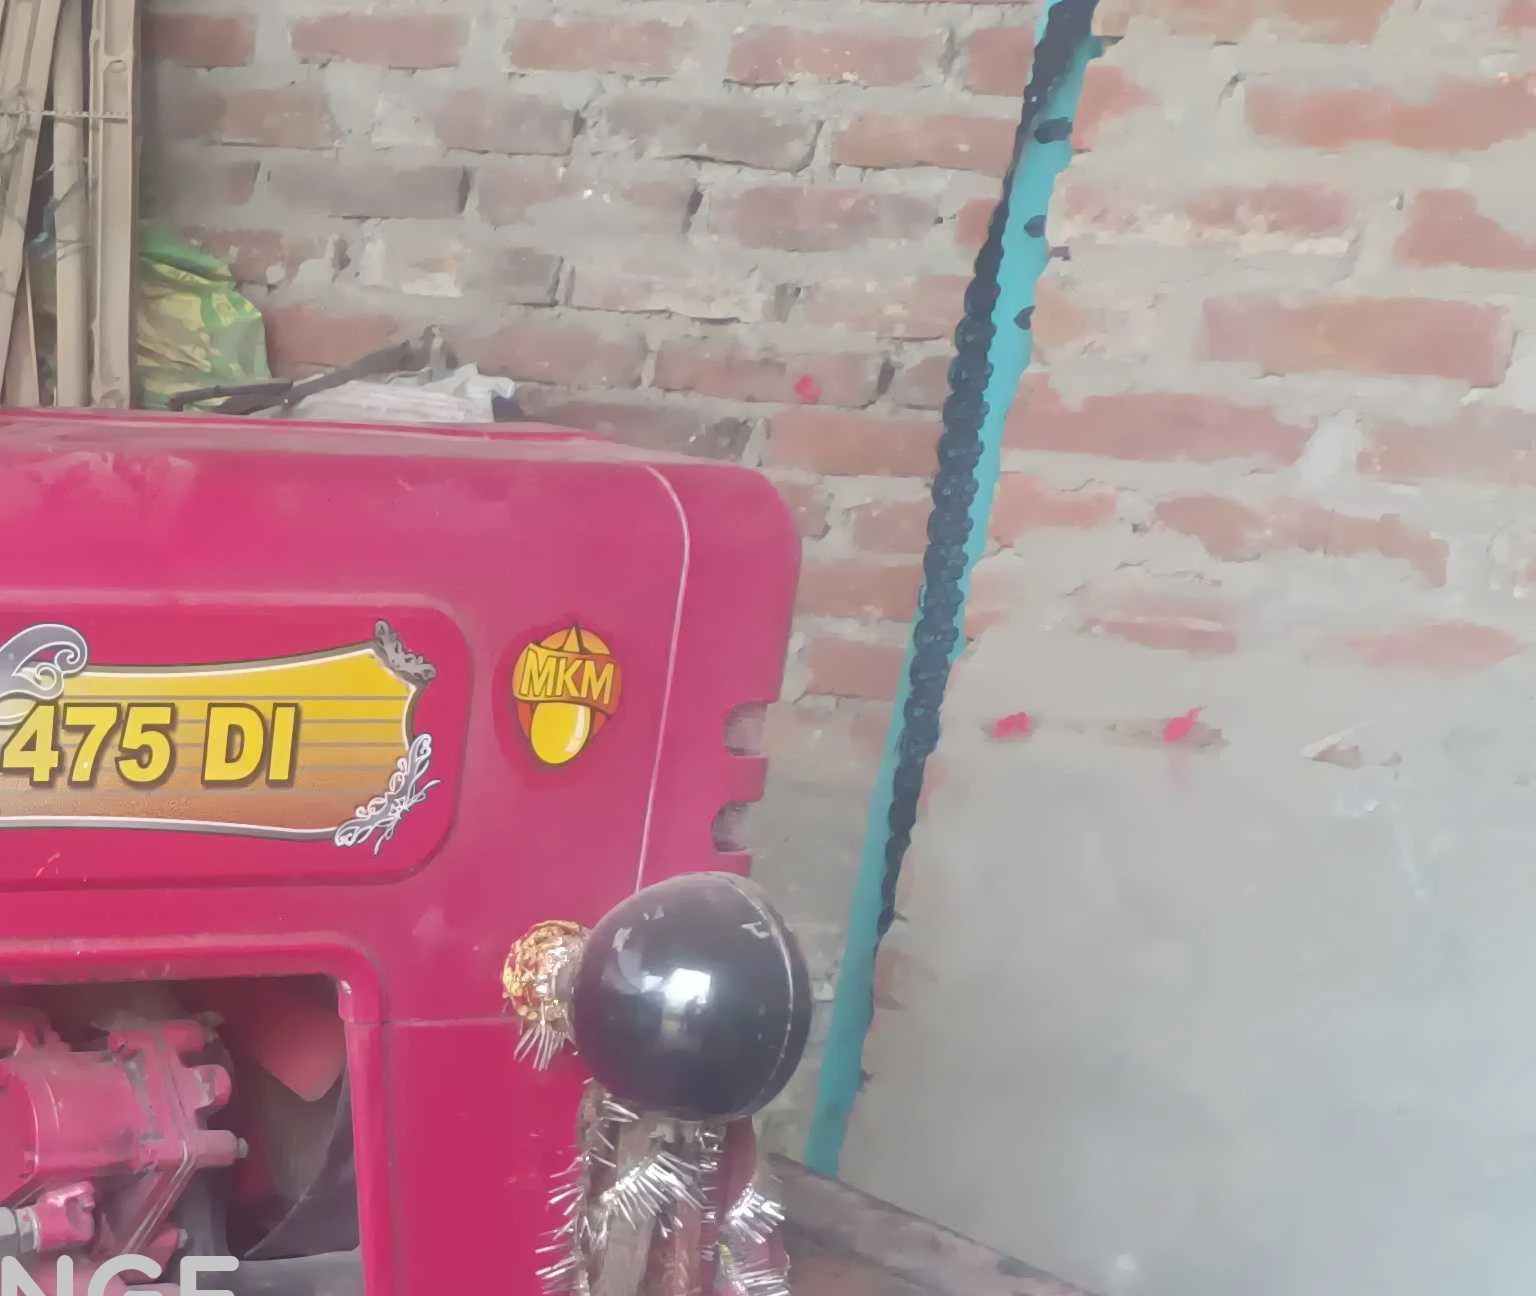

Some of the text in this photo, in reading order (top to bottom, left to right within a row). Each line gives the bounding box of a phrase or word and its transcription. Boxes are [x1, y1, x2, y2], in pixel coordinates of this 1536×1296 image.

[519, 647, 615, 705] MKM
[0, 703, 174, 785] 475
[201, 703, 298, 786] DI
